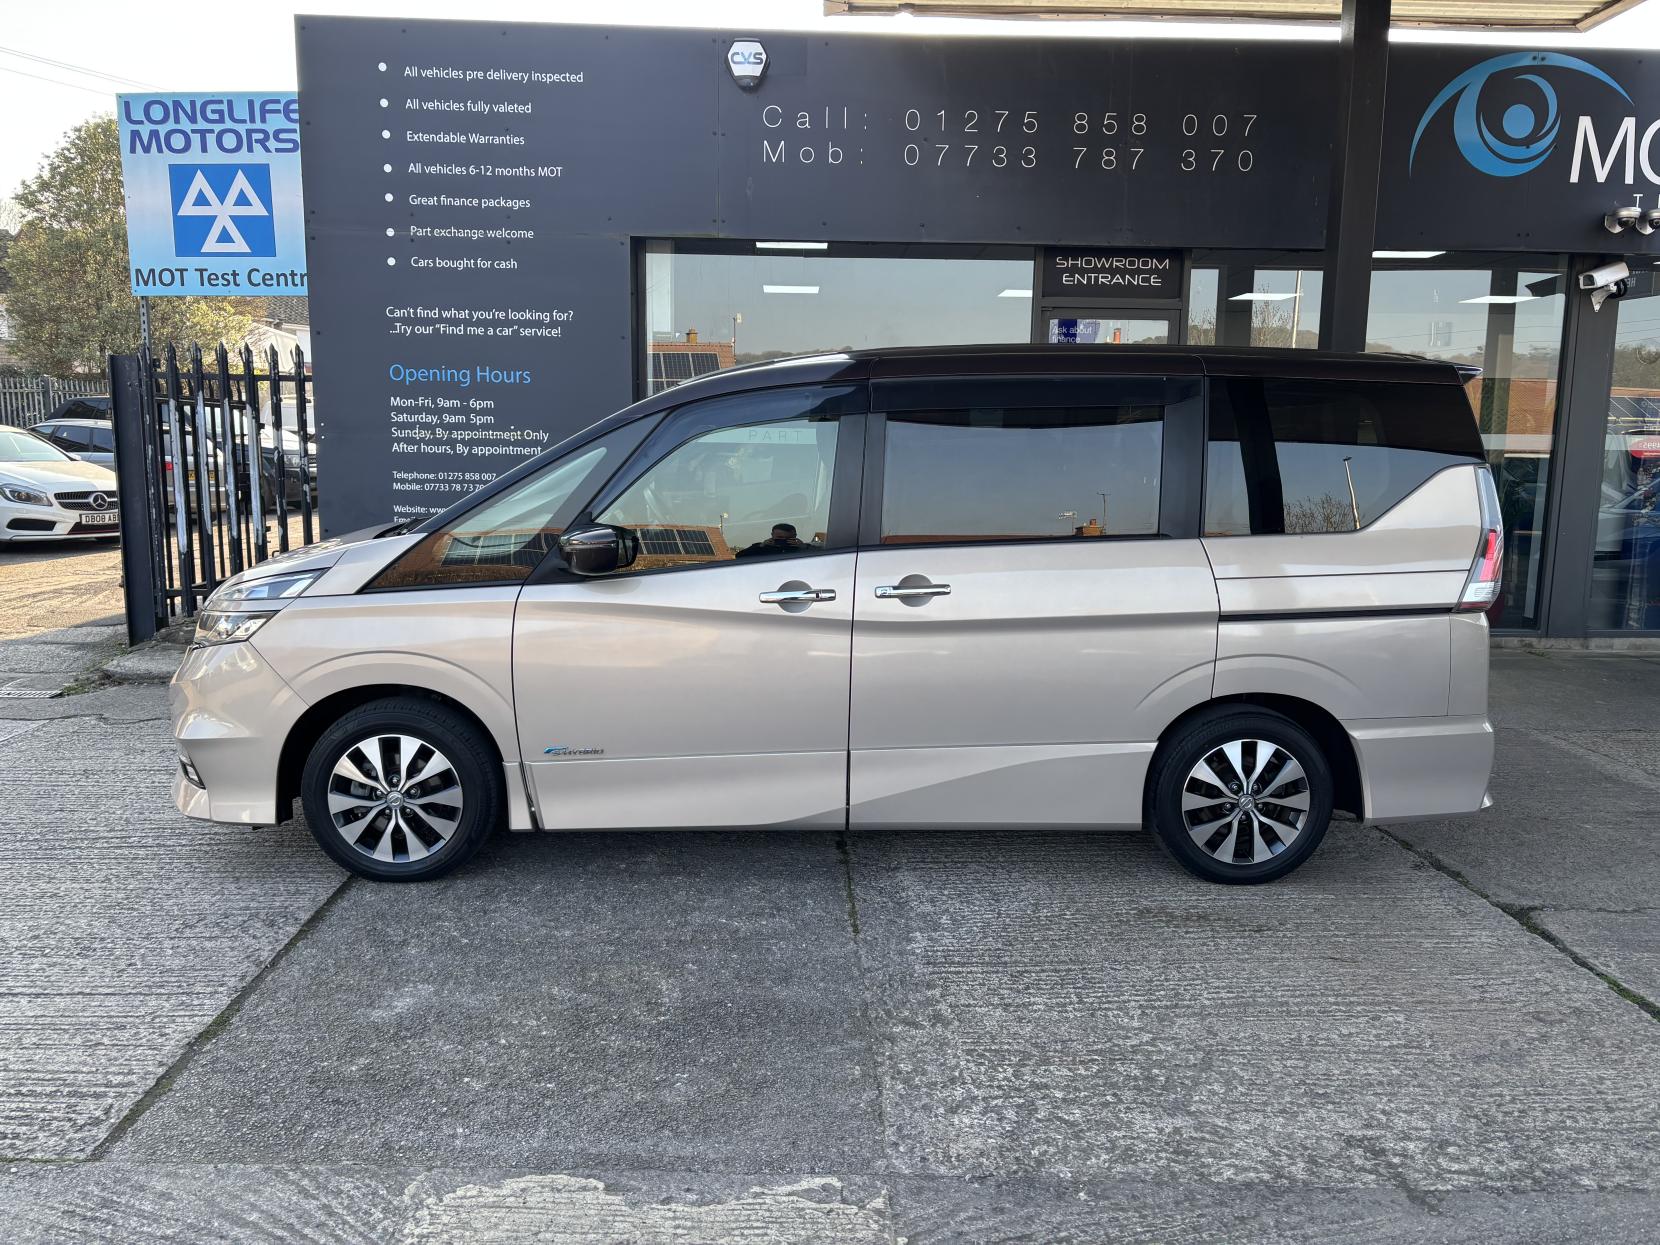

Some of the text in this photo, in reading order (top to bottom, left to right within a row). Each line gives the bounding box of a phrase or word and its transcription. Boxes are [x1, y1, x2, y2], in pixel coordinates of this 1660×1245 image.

[730, 52, 764, 65] CVS
[404, 66, 584, 84] All vehicles pre delivery inspected
[123, 99, 299, 125] LONGLIFE
[406, 99, 532, 114] All vehicles fully valeted
[762, 105, 1257, 136] Call: 01275 858 007
[130, 128, 300, 154] MOTORS
[406, 131, 525, 145] Extendable Warranties
[763, 140, 1253, 172] Mob: 07733 787 370
[408, 163, 563, 177] All vehicles 6-12 months MOT
[409, 195, 531, 210] Great finance packages
[410, 226, 535, 240] Part exchange welcome
[411, 257, 518, 270] Cars bought for cash
[1056, 256, 1169, 270] SHOWROOM
[135, 268, 188, 287] MOT
[195, 268, 240, 287] Test
[1062, 273, 1162, 286] ENTRANCE
[386, 307, 574, 323] Can't find what you're looking for?
[415, 325, 434, 335] our
[467, 326, 485, 335] me
[487, 327, 494, 335] a
[520, 327, 561, 337] service!
[1052, 325, 1092, 334] Ask about
[389, 364, 531, 387] Opening Hours
[390, 397, 435, 408] Mon-Fri,
[437, 398, 460, 408] 9am
[469, 399, 494, 410] 6pm
[391, 412, 494, 425] Saturday, 9am 5pm
[391, 428, 549, 443] Sunday, By appointment Only
[392, 443, 542, 456] After hours, By appointment
[392, 471, 437, 480] Telephone:
[438, 472, 463, 480] 01275
[393, 483, 423, 491] Mobile:
[424, 483, 449, 491] 07733
[394, 505, 428, 513] Website:
[85, 514, 119, 523] DB08 AB
